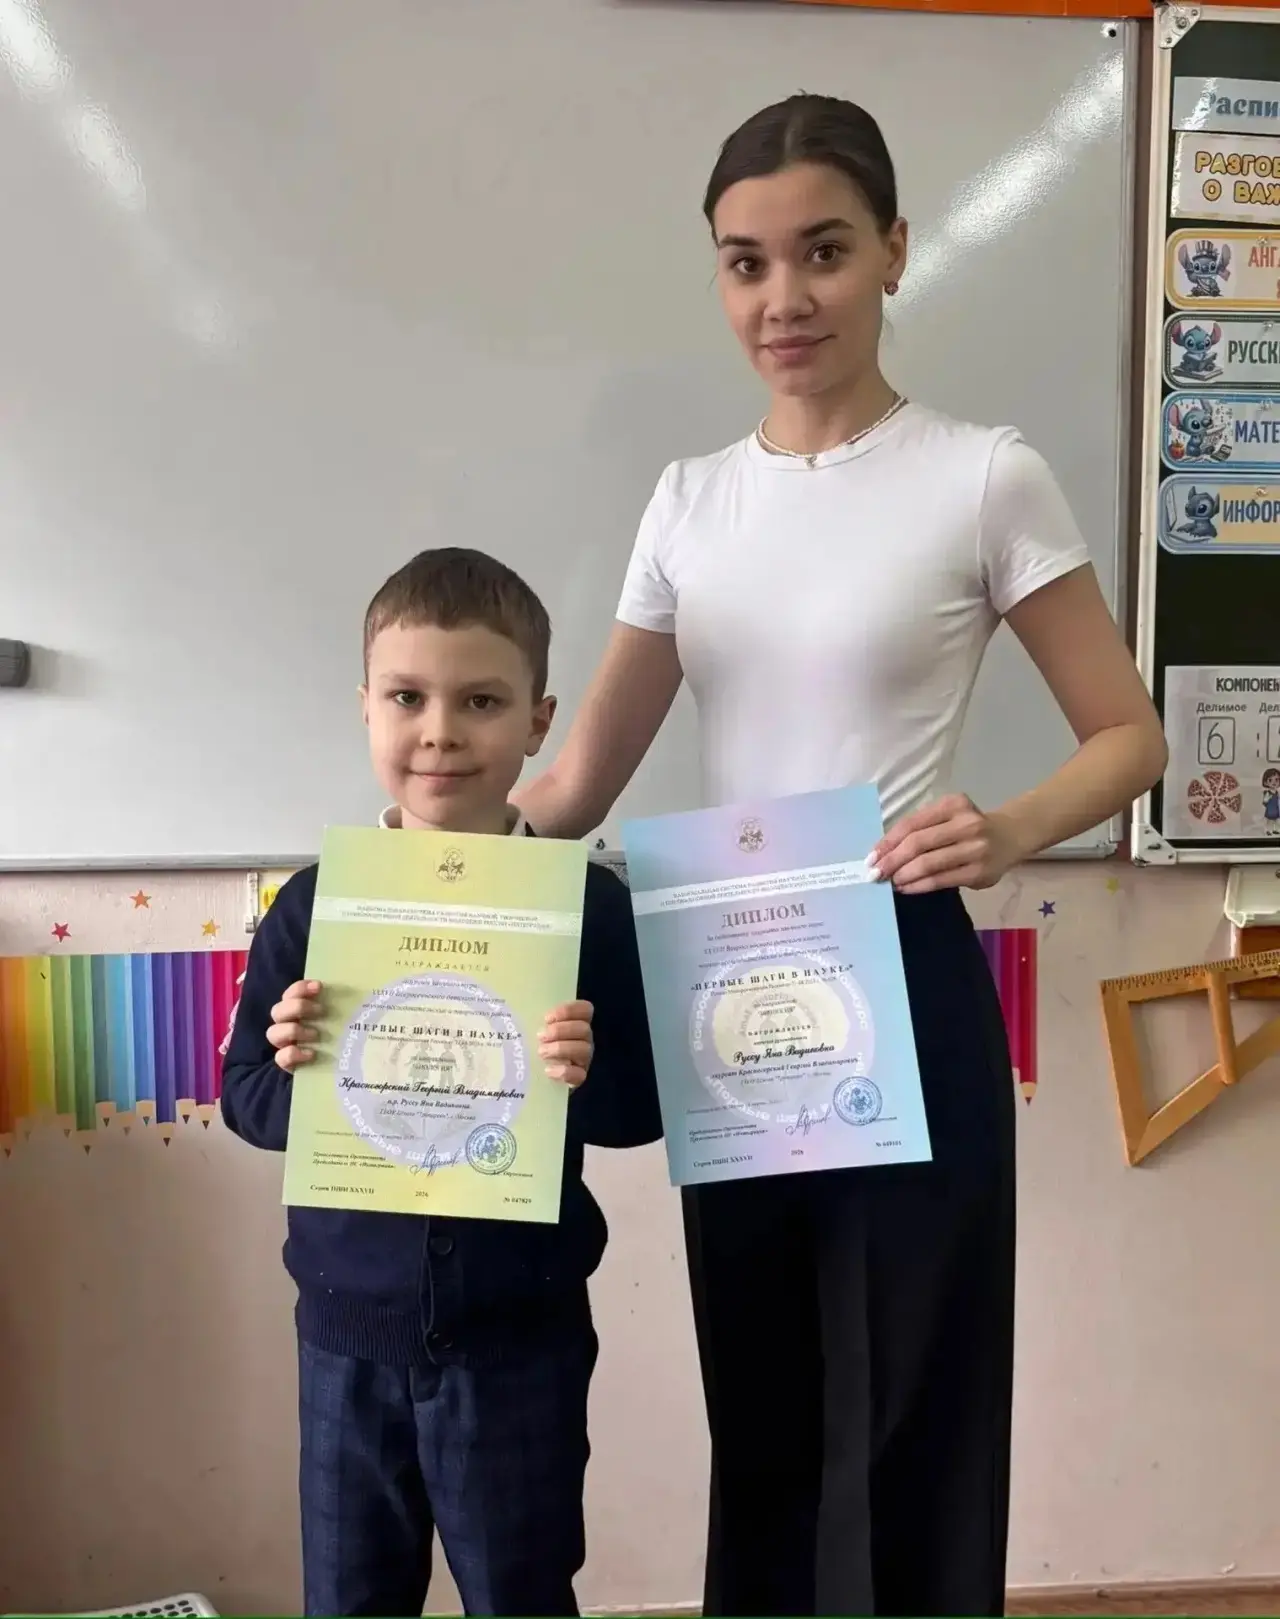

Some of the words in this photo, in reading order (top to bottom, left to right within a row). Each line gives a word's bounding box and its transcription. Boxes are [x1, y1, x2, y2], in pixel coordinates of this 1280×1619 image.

[1202, 179, 1222, 202] О
[1248, 247, 1280, 268] АНГ
[1228, 340, 1280, 364] РУССК
[1235, 421, 1280, 443] МАТЕ
[1223, 500, 1280, 523] ИНФОР
[1197, 702, 1247, 714] Делимое
[1207, 722, 1224, 760] 6
[721, 903, 806, 928] ДИПЛОМ
[398, 936, 490, 955] ДИПЛОМ
[395, 960, 490, 972] НАГРАЖДАЕТСЯ
[751, 971, 786, 984] ШАГИ
[792, 971, 798, 979] В
[413, 1027, 450, 1037] ШАГИ
[457, 1029, 464, 1038] В
[733, 1051, 761, 1065] Руссу
[762, 1047, 782, 1059] Яна
[784, 1042, 835, 1058] Вадимовна
[339, 1076, 411, 1094] Красногорский
[412, 1081, 451, 1097] Георгий
[453, 1083, 526, 1100] Владимирович
